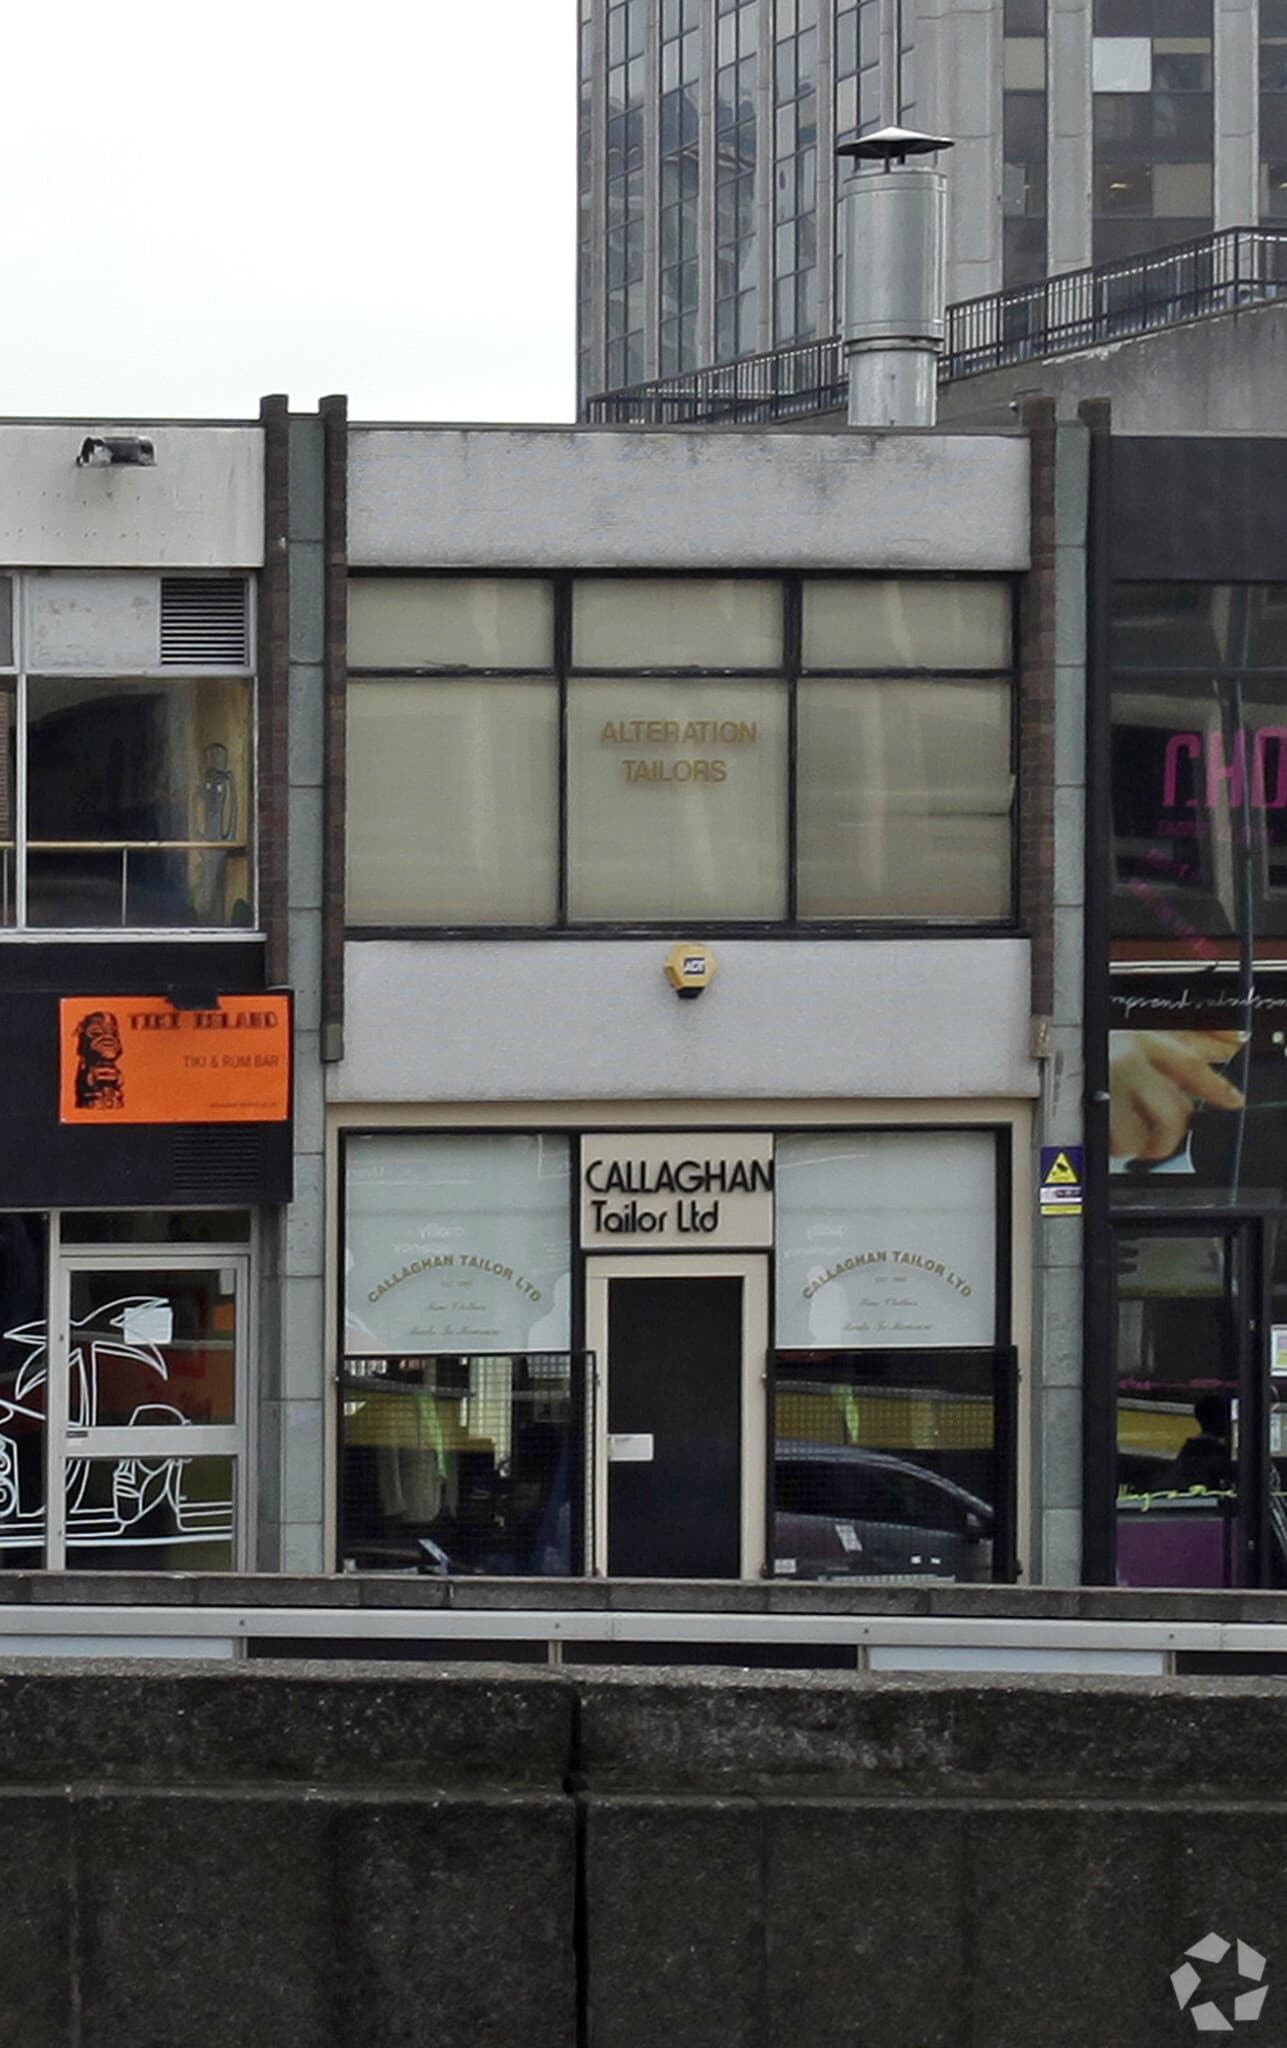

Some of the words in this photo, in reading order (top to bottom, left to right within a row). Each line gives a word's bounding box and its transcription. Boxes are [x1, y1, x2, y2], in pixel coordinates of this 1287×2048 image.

[600, 720, 758, 744] ALTERATION
[621, 760, 728, 783] TAILORS
[222, 1055, 251, 1068] RUM
[585, 1159, 775, 1193] CALLAGHAN
[590, 1200, 668, 1233] Tailor
[676, 1200, 719, 1233] Ltd
[367, 1255, 454, 1304] CALLAGHAN
[459, 1254, 513, 1281] TAILOR
[515, 1276, 542, 1302] LTD
[802, 1251, 887, 1299] CALLAGHAN
[892, 1251, 946, 1277] TAILOR
[947, 1272, 973, 1298] LTD
